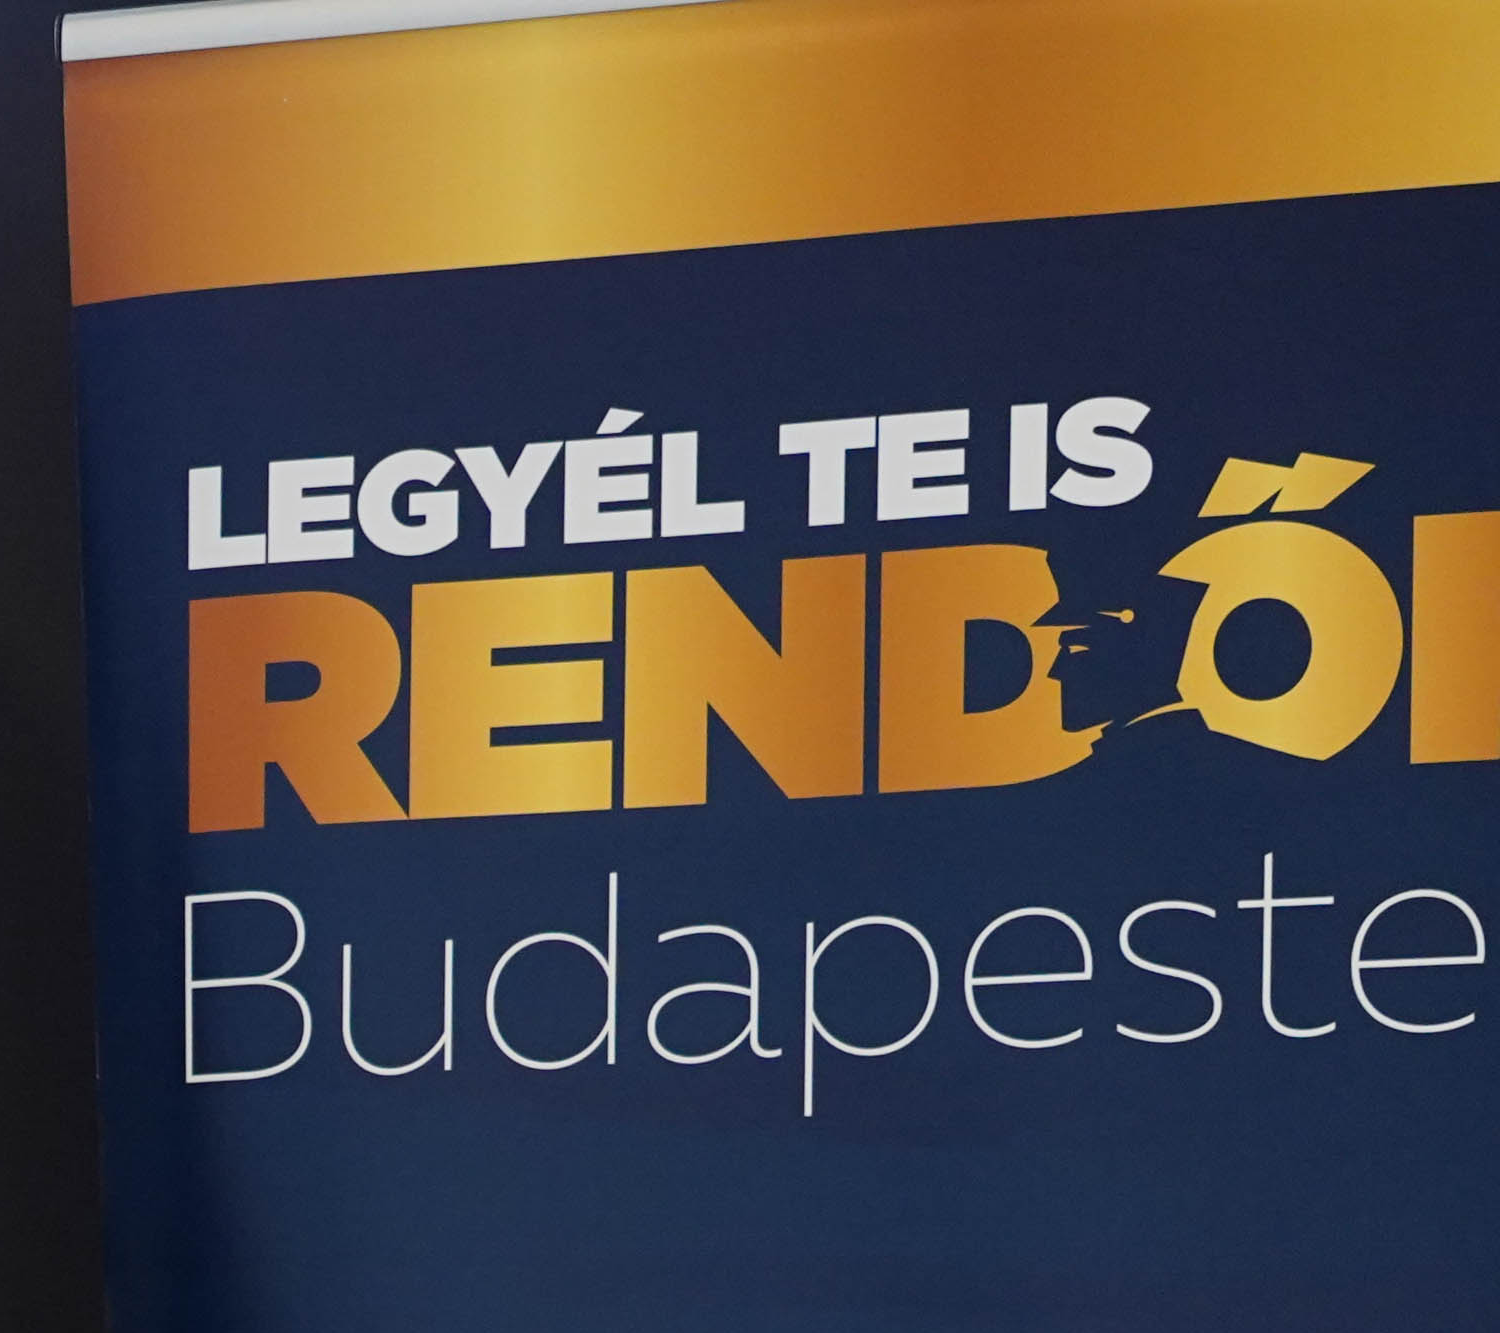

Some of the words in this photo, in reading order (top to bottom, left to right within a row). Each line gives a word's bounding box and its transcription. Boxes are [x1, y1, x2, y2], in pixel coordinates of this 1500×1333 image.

[188, 407, 745, 571] LEGYÉL
[778, 408, 970, 527] TE
[1009, 396, 1153, 512] IS
